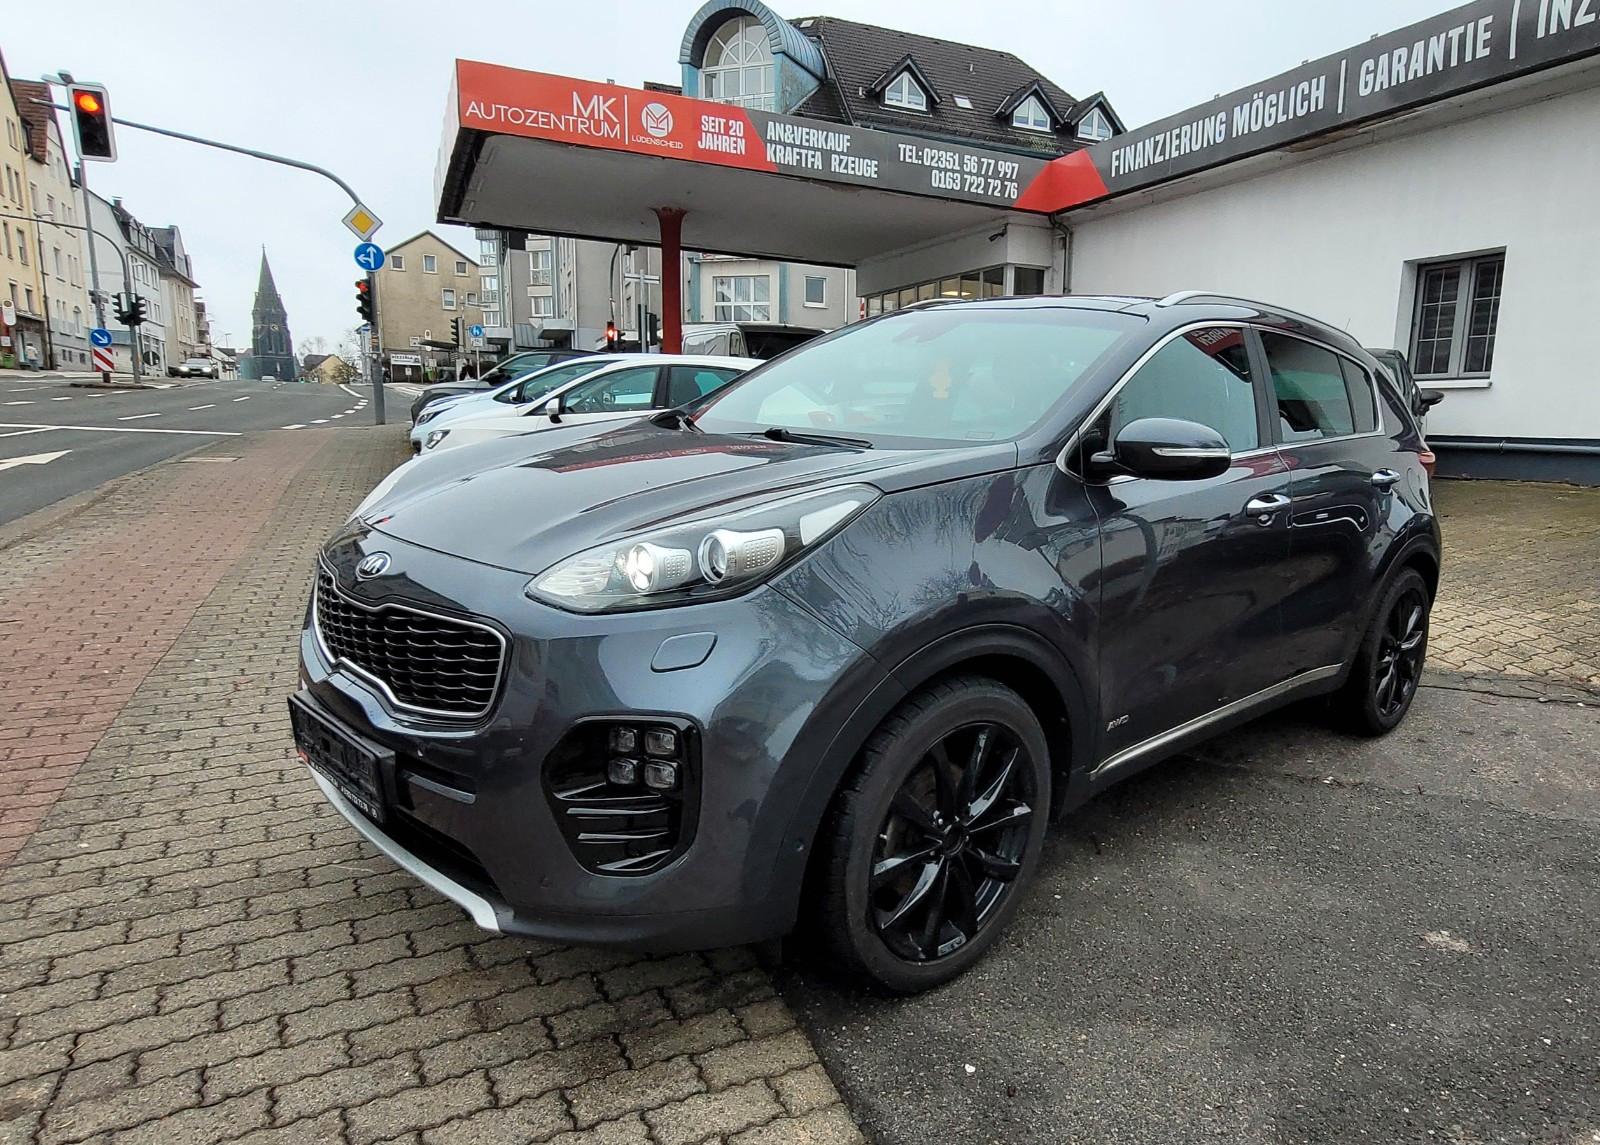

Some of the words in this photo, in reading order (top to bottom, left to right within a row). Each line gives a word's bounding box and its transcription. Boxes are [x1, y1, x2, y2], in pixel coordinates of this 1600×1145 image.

[1358, 15, 1494, 97] GARANTIE
[465, 101, 620, 139] AUTOZENTRUM
[572, 91, 620, 123] MK
[631, 134, 684, 149] LÜDENSCHEID
[701, 115, 727, 134] SEIT
[728, 120, 744, 137] 20
[766, 120, 851, 153] AN&VERKAUF
[1111, 111, 1226, 178] FINANZIERUNG
[1231, 74, 1326, 138] MÖGLICH
[697, 132, 746, 155] JAHREN
[766, 142, 823, 170] KRAFTFA
[830, 153, 879, 179] RZEUGE
[963, 154, 979, 173] 56
[980, 157, 996, 176] 77
[997, 160, 1019, 180] 997
[931, 169, 961, 191] 0163
[963, 174, 984, 194] 722
[987, 178, 1002, 197] 72
[1003, 181, 1019, 200] 76
